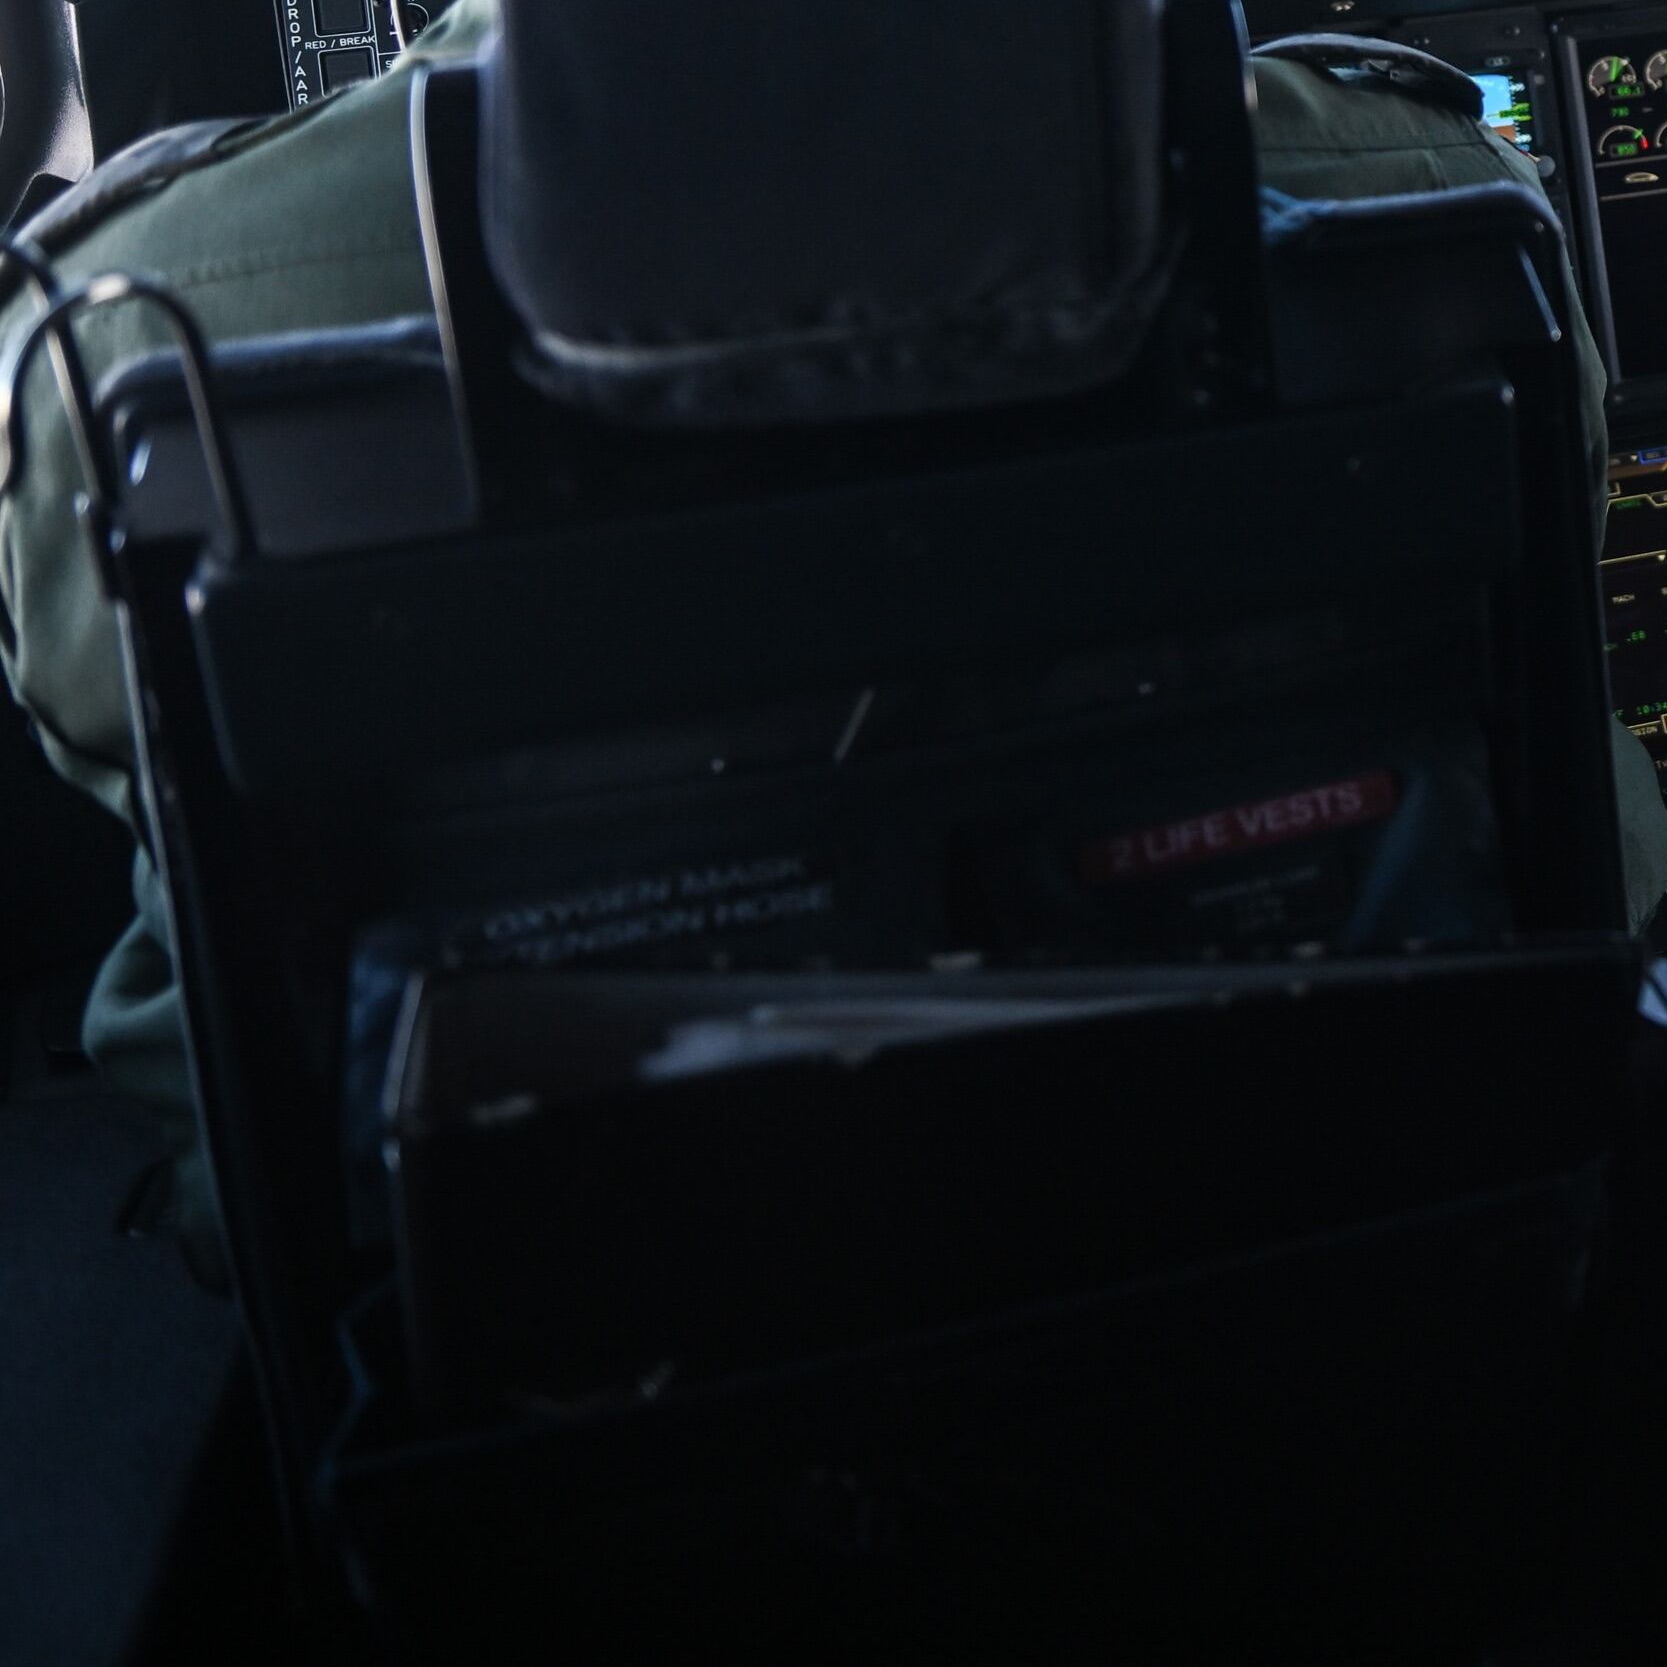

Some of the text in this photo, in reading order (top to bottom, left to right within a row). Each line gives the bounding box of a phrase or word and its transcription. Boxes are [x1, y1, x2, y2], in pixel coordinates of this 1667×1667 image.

[304, 40, 326, 50] RED
[339, 36, 376, 46] BREAK
[1143, 816, 1227, 862] LIFE
[1238, 780, 1364, 839] VESTS
